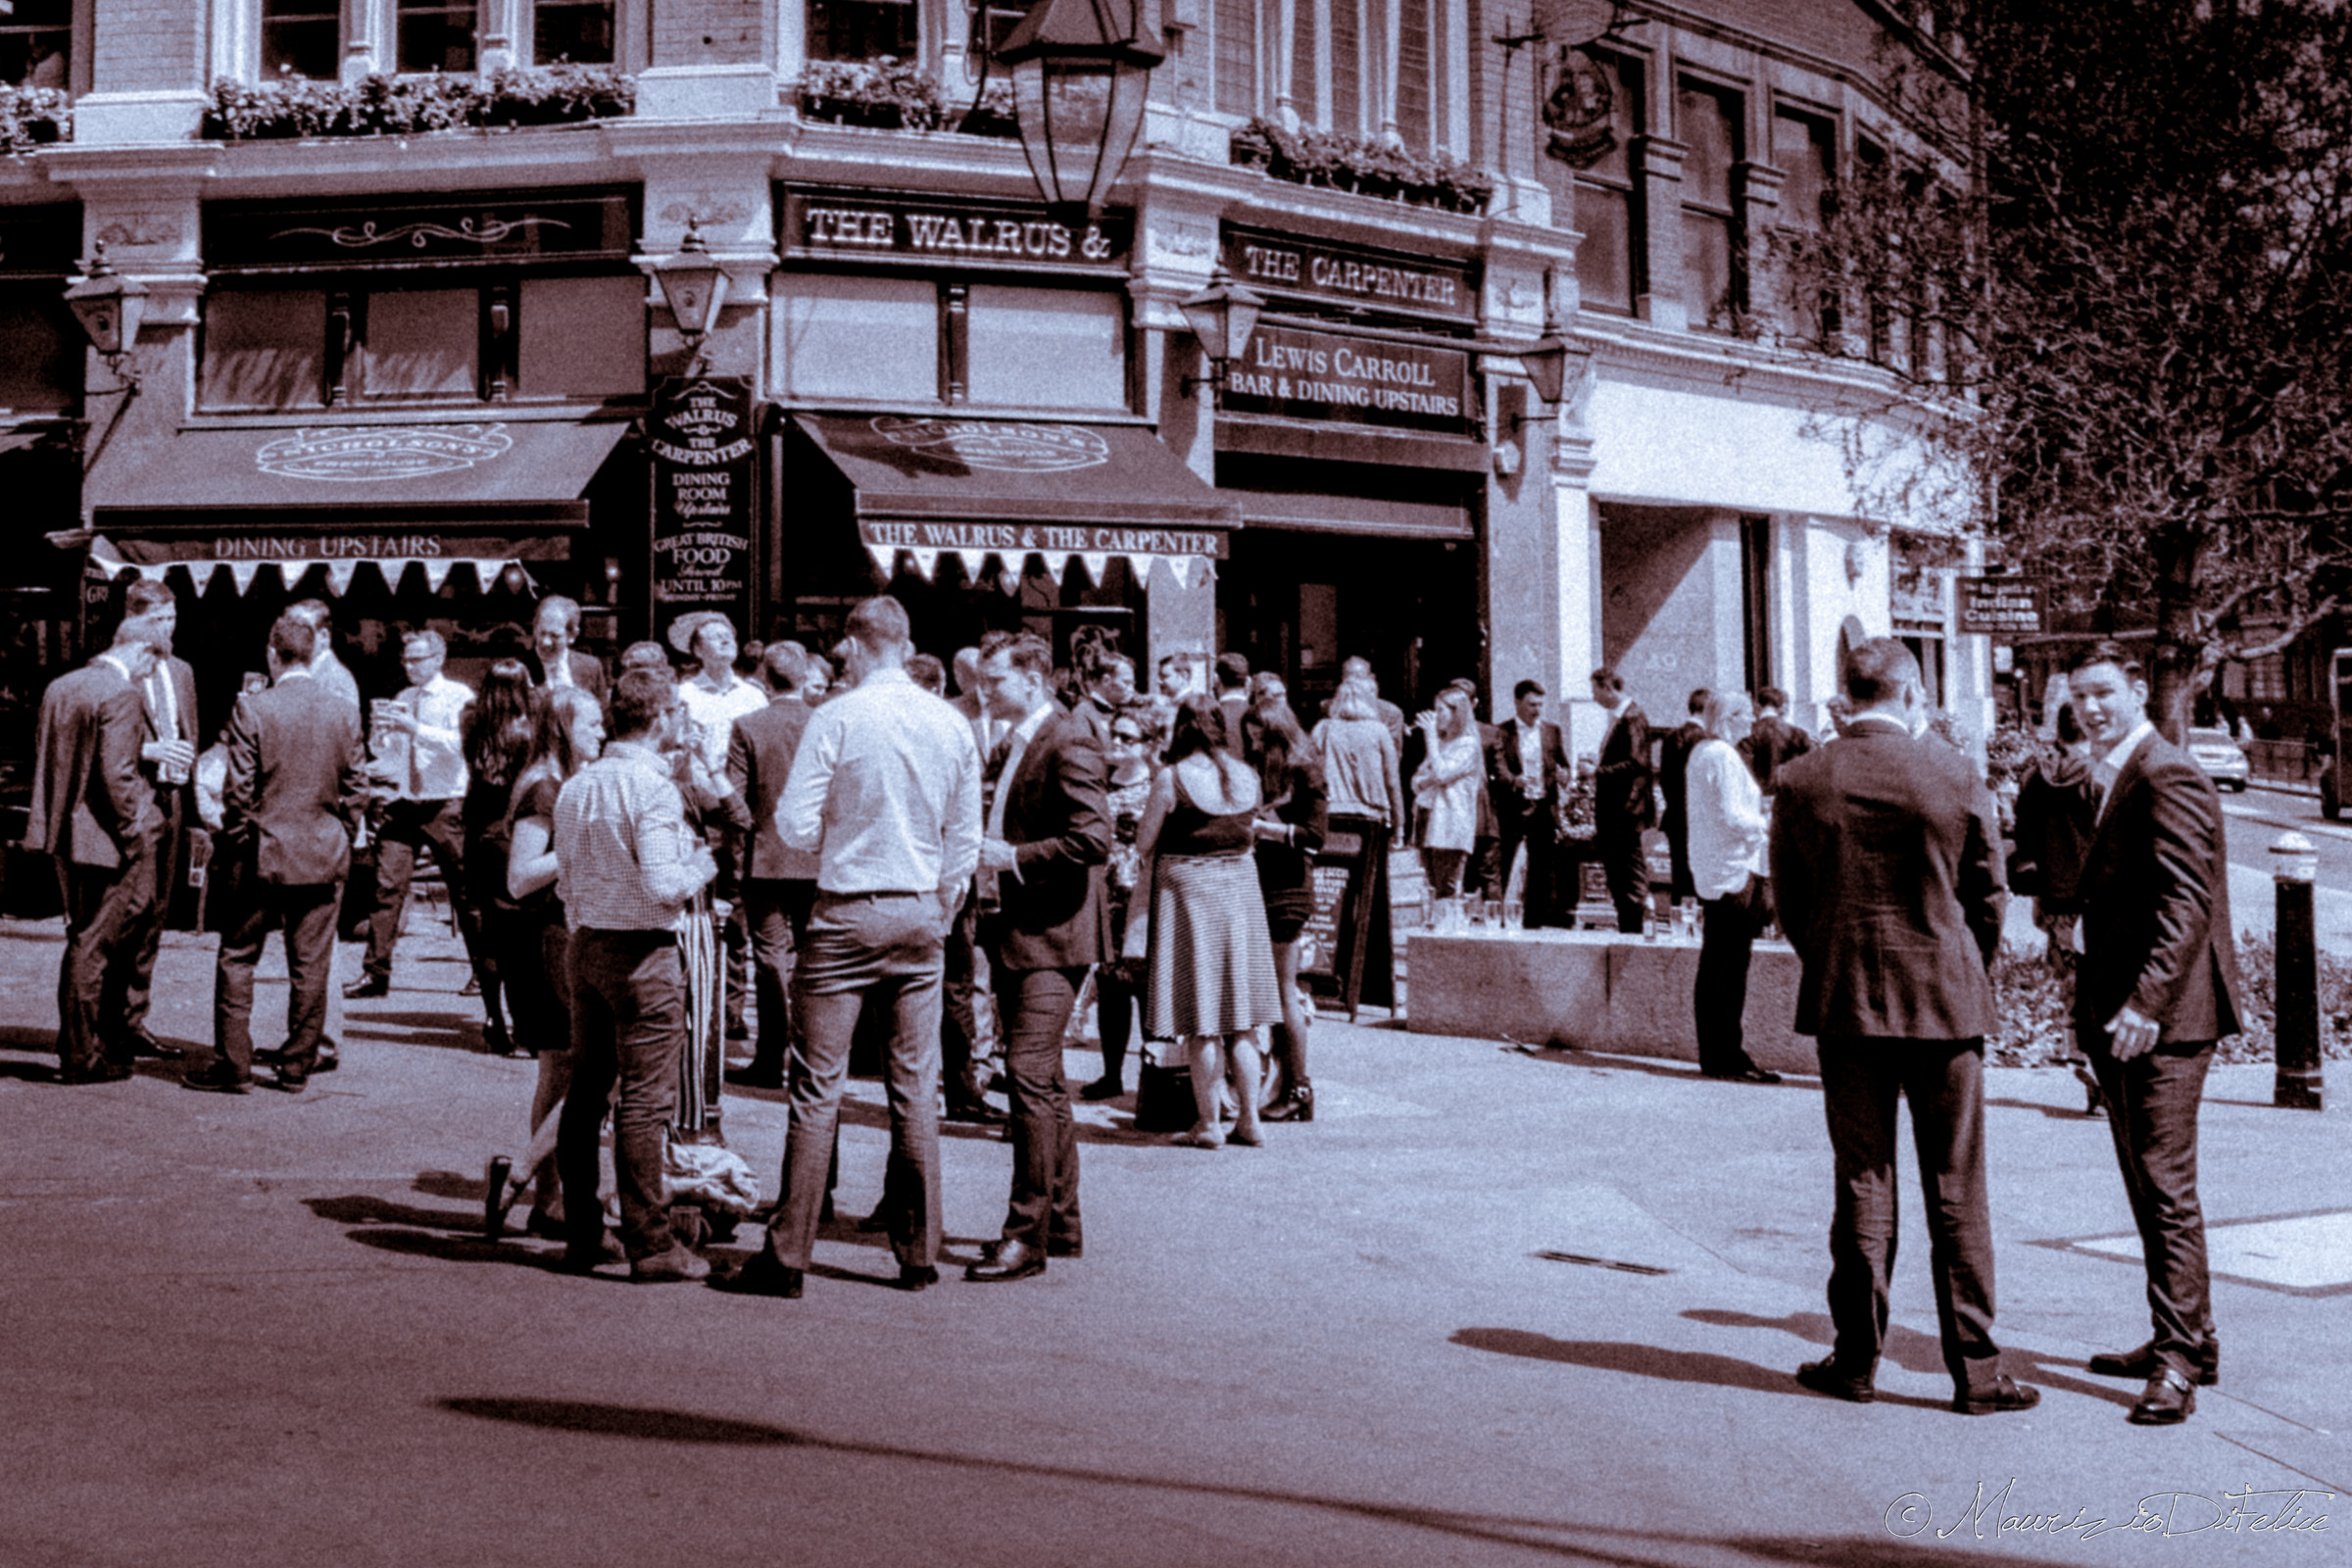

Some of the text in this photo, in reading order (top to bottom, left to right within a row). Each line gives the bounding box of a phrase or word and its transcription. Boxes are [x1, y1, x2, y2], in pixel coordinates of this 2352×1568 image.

[807, 208, 1110, 258] THE WALRUS &
[1246, 245, 1455, 306] THE CARPENTER
[689, 397, 717, 409] THE
[1231, 372, 1459, 416] BAR & DINING UPSTAIRS
[664, 409, 738, 429] WALRUS
[651, 437, 754, 466] CARPENTER
[688, 437, 716, 449] THE
[672, 472, 730, 486] DINING
[677, 487, 727, 501] ROOM
[215, 534, 441, 558] DINING UPSTAIRS
[655, 532, 748, 553] GREAT BRITISH
[869, 522, 1218, 555] THE WALRUS & THE CARPENTER
[672, 548, 731, 564] FOOD
[661, 579, 708, 592] UNTIL
[1970, 596, 2033, 609] Indian
[1964, 609, 2038, 622] Cuisine
